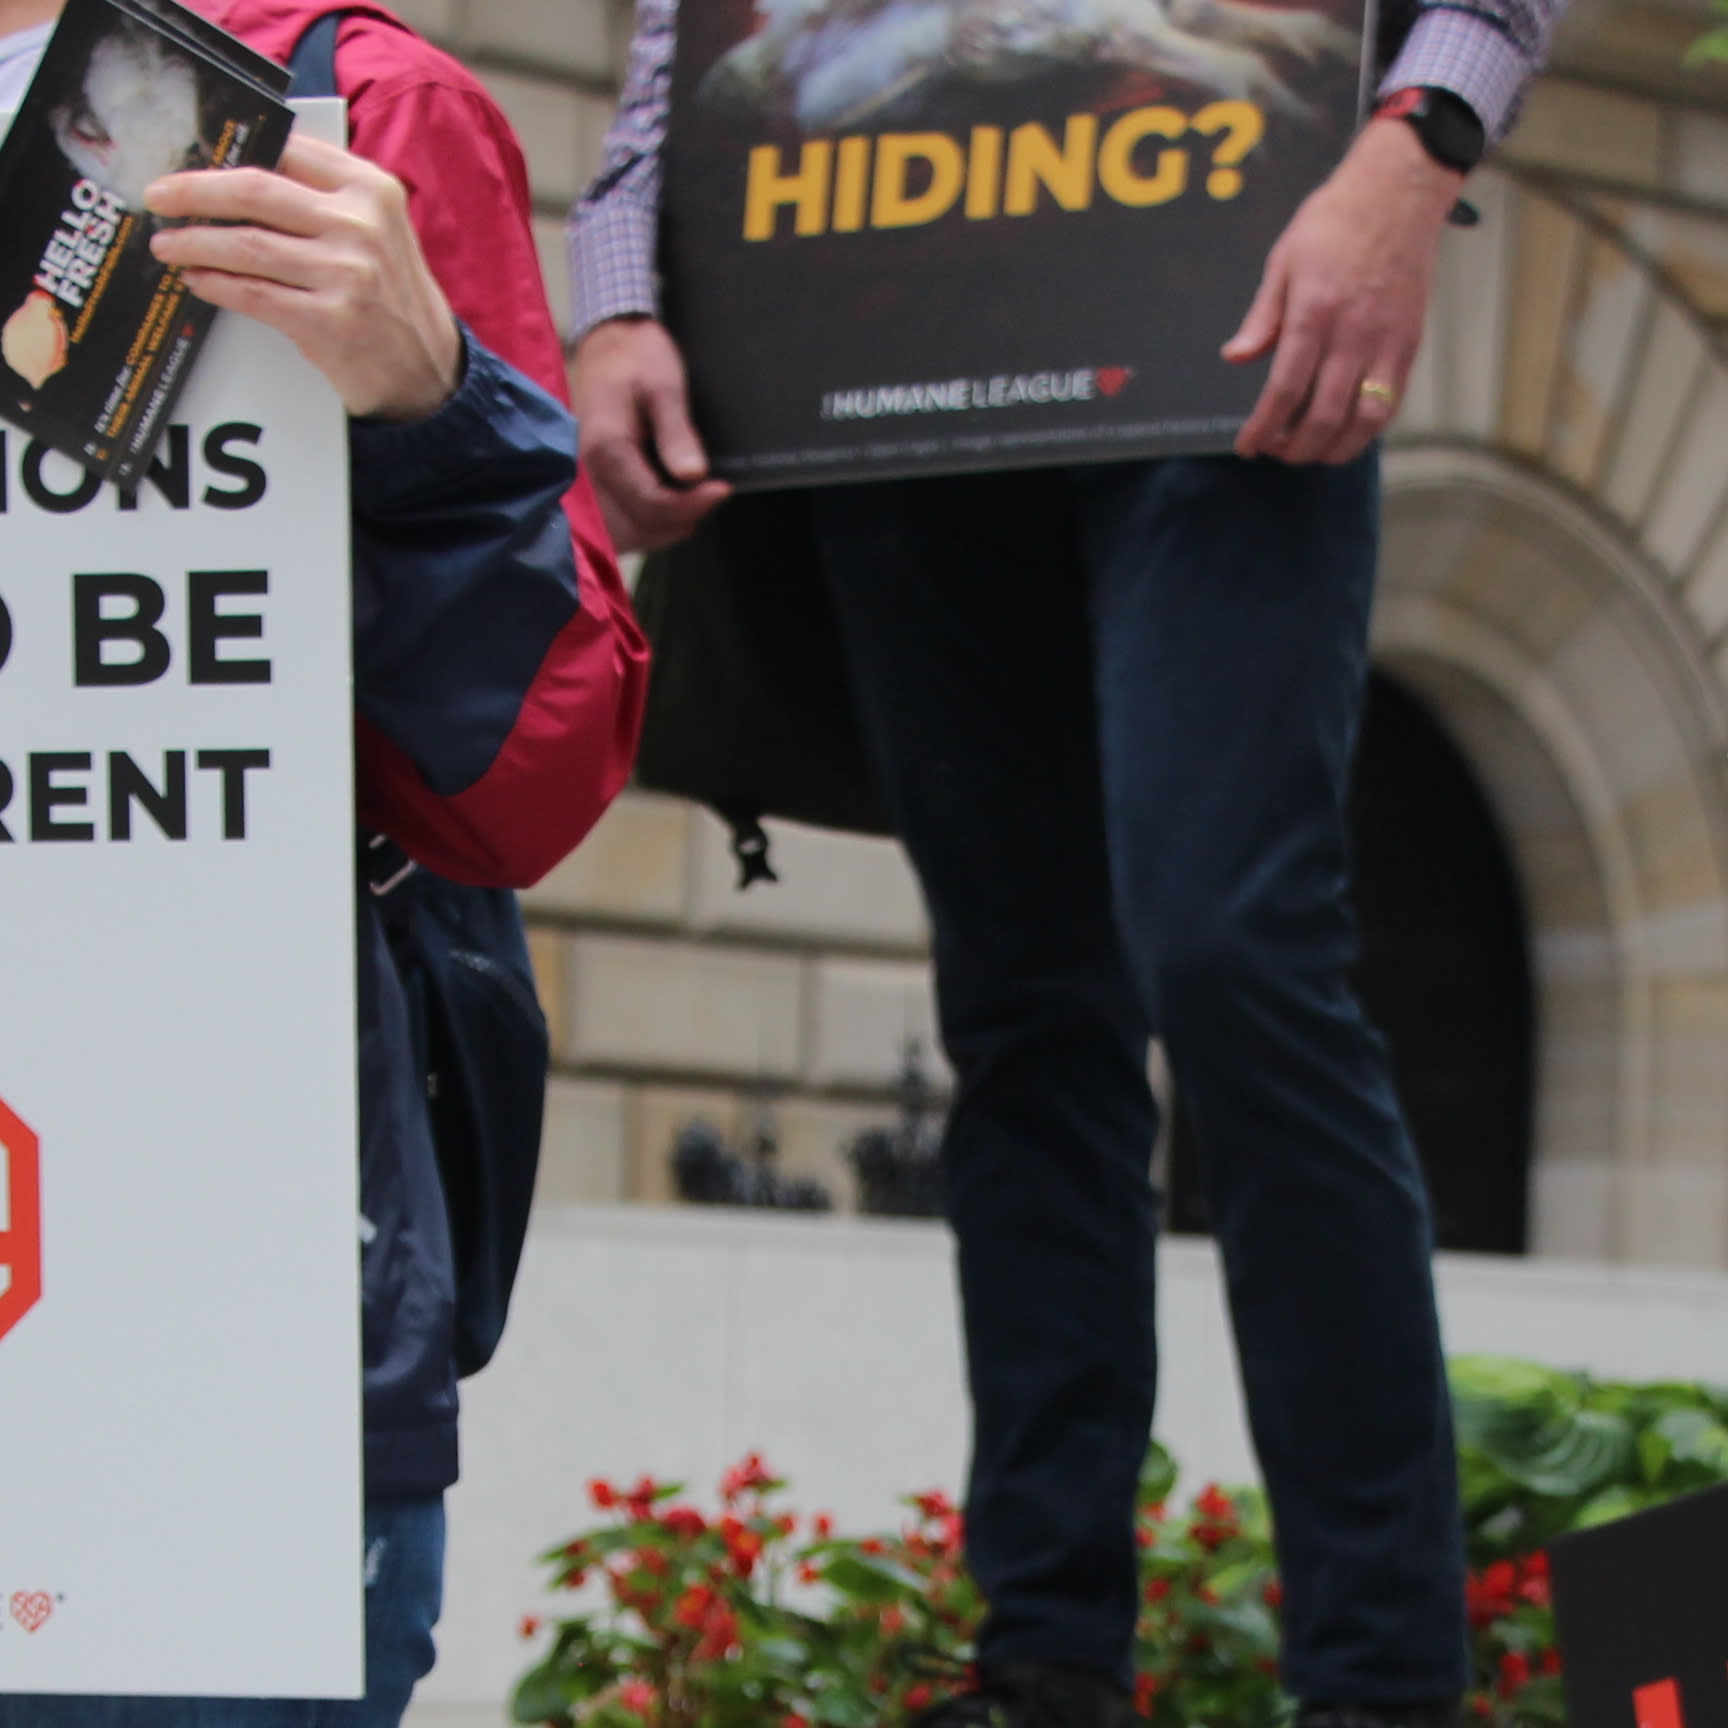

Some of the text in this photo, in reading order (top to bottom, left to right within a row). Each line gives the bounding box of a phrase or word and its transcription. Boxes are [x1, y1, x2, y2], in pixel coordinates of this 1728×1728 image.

[743, 99, 1265, 243] HIDING?
[34, 178, 99, 294] HELLO
[56, 190, 128, 308] FRESH
[831, 379, 970, 420] HUMANE
[971, 368, 1095, 408] LEAGUE
[72, 568, 273, 689] BE
